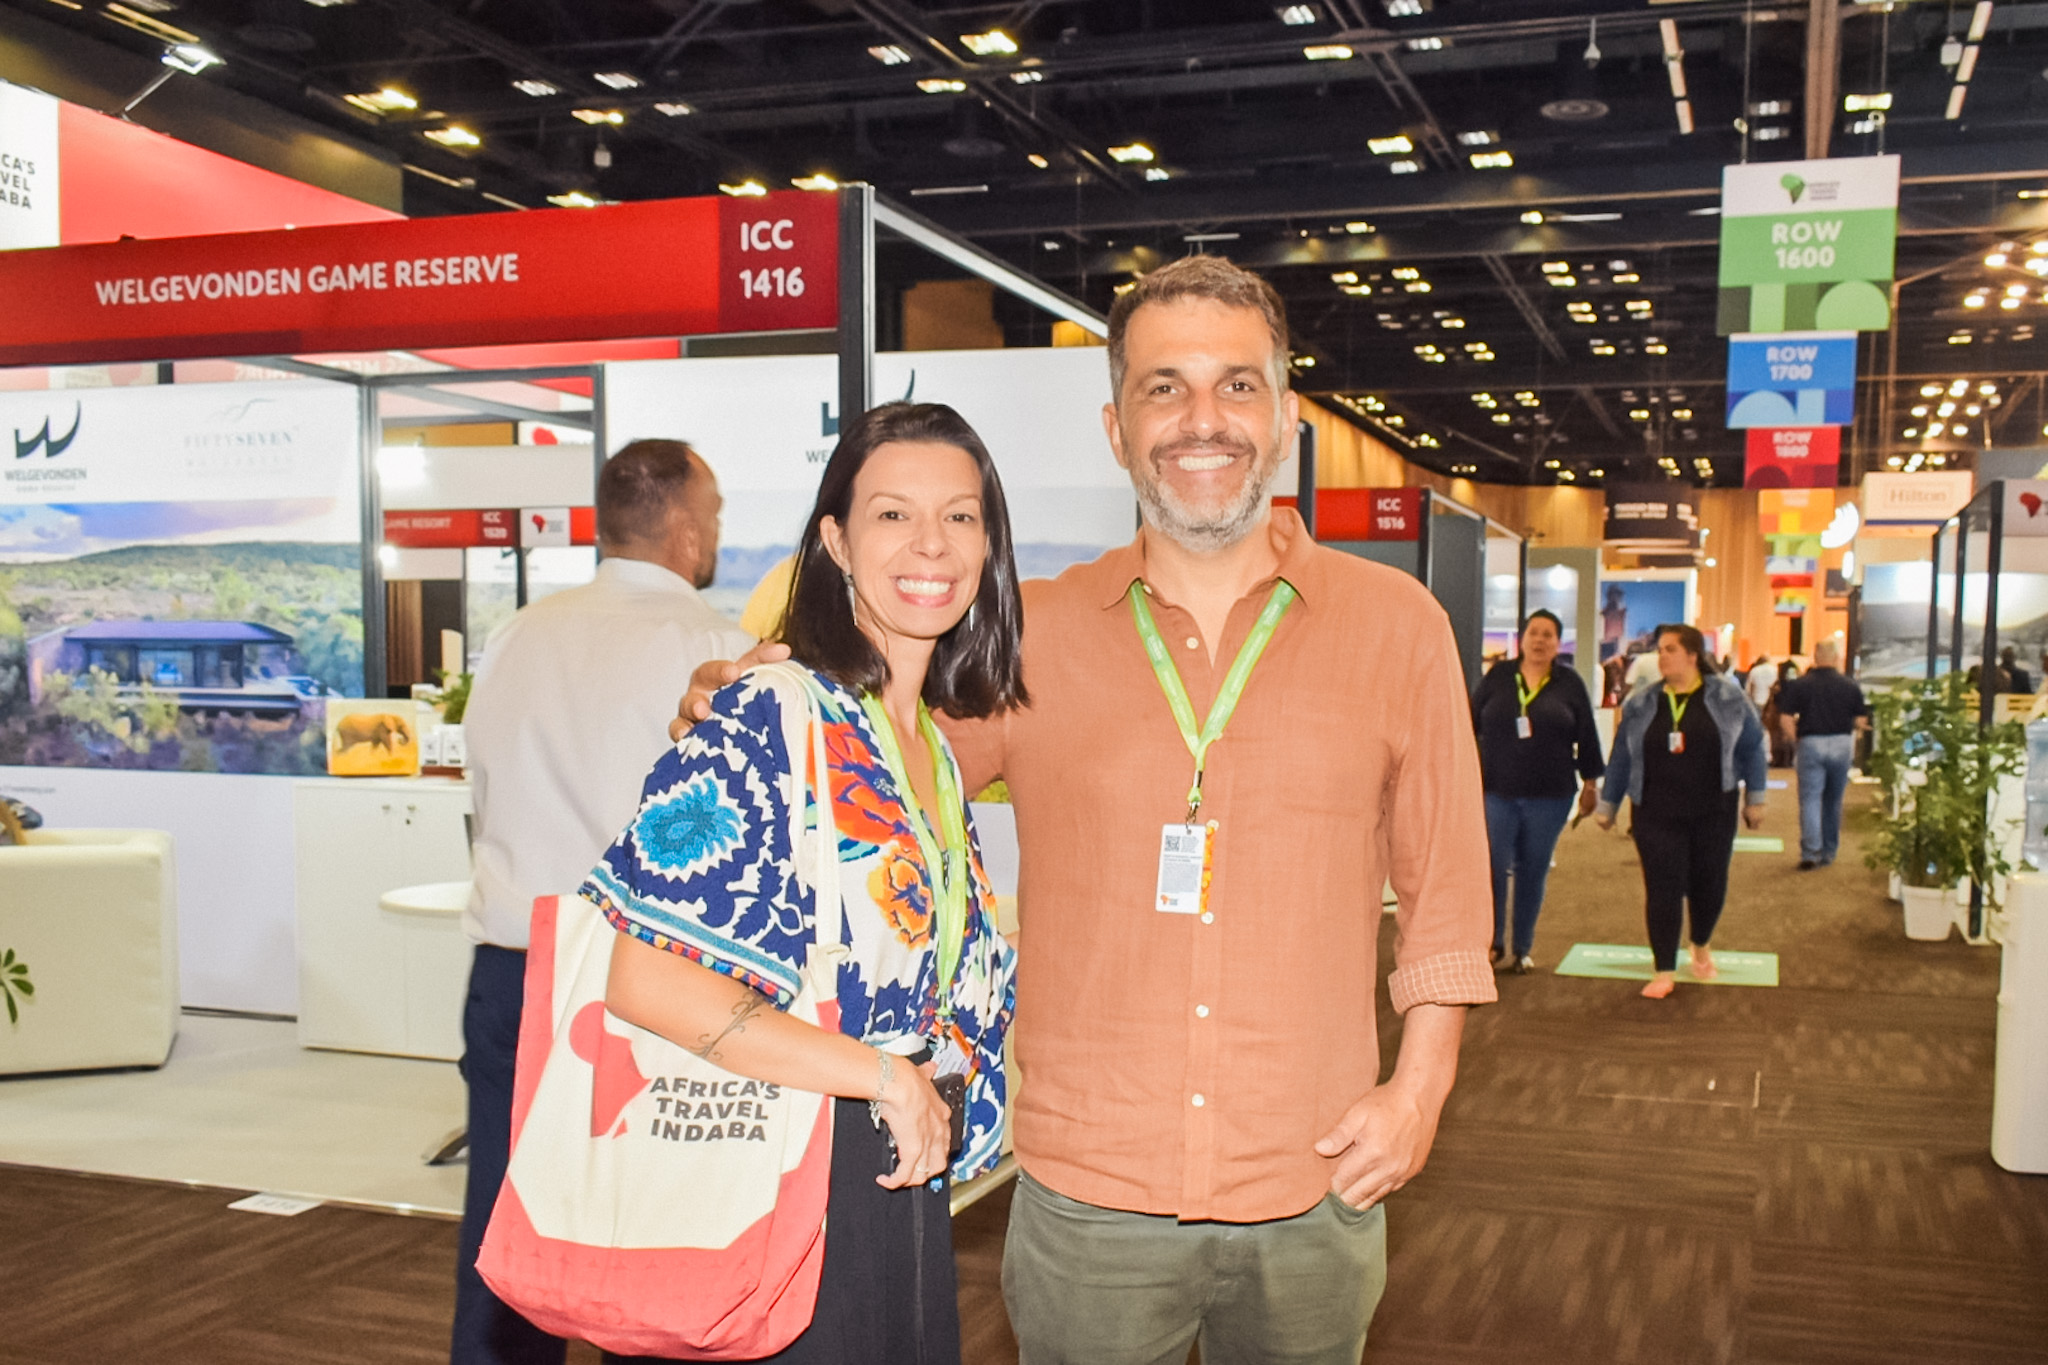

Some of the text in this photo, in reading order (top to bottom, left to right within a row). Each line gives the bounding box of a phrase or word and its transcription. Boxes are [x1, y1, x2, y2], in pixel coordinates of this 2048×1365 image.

[740, 219, 794, 252] ICC
[1771, 220, 1843, 245] ROW
[1774, 246, 1836, 269] 1600
[95, 253, 519, 306] WELGEVONDEN GAME RESERVE
[739, 266, 805, 299] 1416
[1766, 346, 1819, 363] ROW
[1770, 364, 1813, 381] 1700
[4, 468, 87, 481] WELGEVONDEN
[1377, 497, 1401, 511] ICC
[650, 1076, 781, 1100] AFRICA'S
[656, 1097, 769, 1120] TRAVEL
[651, 1119, 766, 1142] INDABA
